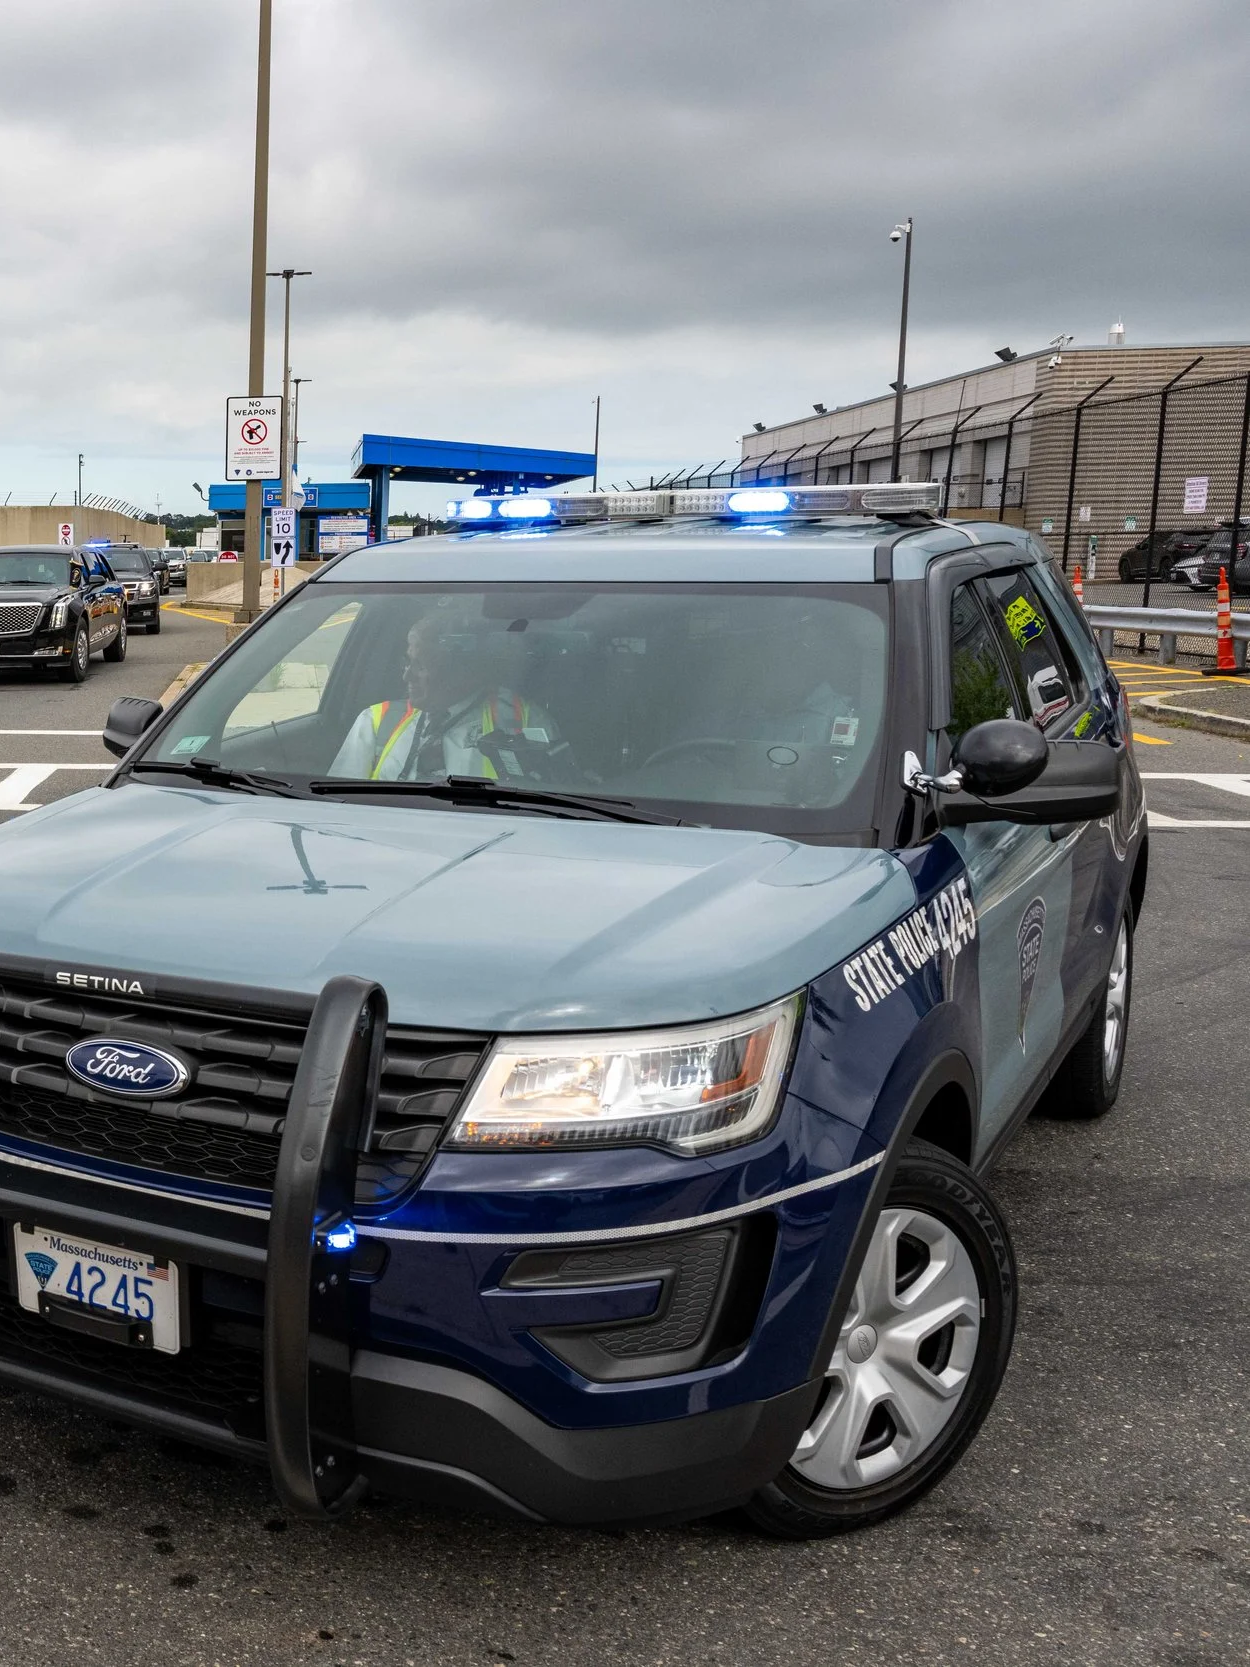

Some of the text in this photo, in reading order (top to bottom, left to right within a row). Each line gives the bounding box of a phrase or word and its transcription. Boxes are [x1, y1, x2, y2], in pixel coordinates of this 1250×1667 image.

[233, 408, 277, 416] WEAPONS
[248, 400, 261, 408] NO
[276, 523, 291, 534] 10
[843, 877, 976, 1012] STATE POLICE 4245
[1022, 932, 1041, 968] STATE
[55, 971, 145, 995] SETINA
[86, 1046, 155, 1084] Ford
[30, 1260, 53, 1271] STATE
[49, 1236, 139, 1272] Massachusetts
[65, 1261, 154, 1321] 4245
